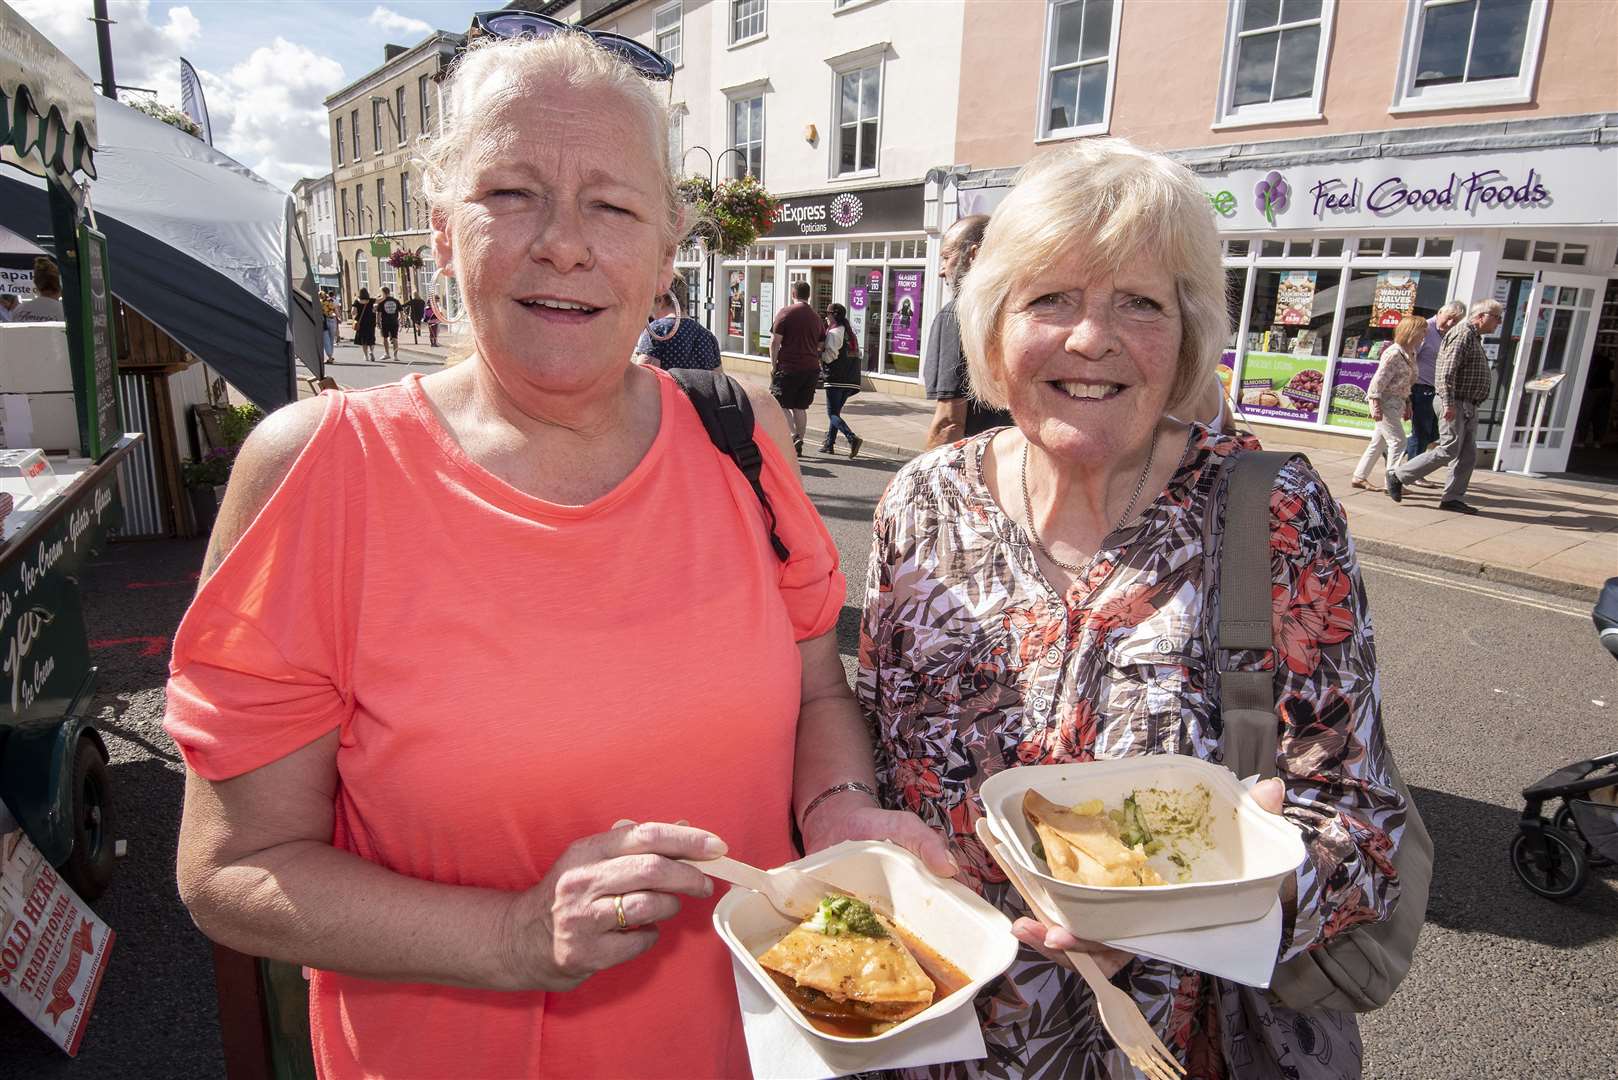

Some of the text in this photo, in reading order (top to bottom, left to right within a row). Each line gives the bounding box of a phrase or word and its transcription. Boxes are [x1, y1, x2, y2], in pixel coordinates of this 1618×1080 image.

[1309, 168, 1548, 216] Feel Good Foods
[801, 222, 827, 234] Opticians
[8, 284, 31, 294] Taste
[1245, 406, 1310, 420] www.grapetree.co.uk
[21, 655, 56, 711] Ice Cream
[0, 864, 58, 987] SOLD HERE
[20, 893, 71, 994] TRADITIONAL
[34, 955, 57, 1001] ITALIAN
[52, 937, 65, 959] ICE
[61, 904, 78, 941] CREAM
